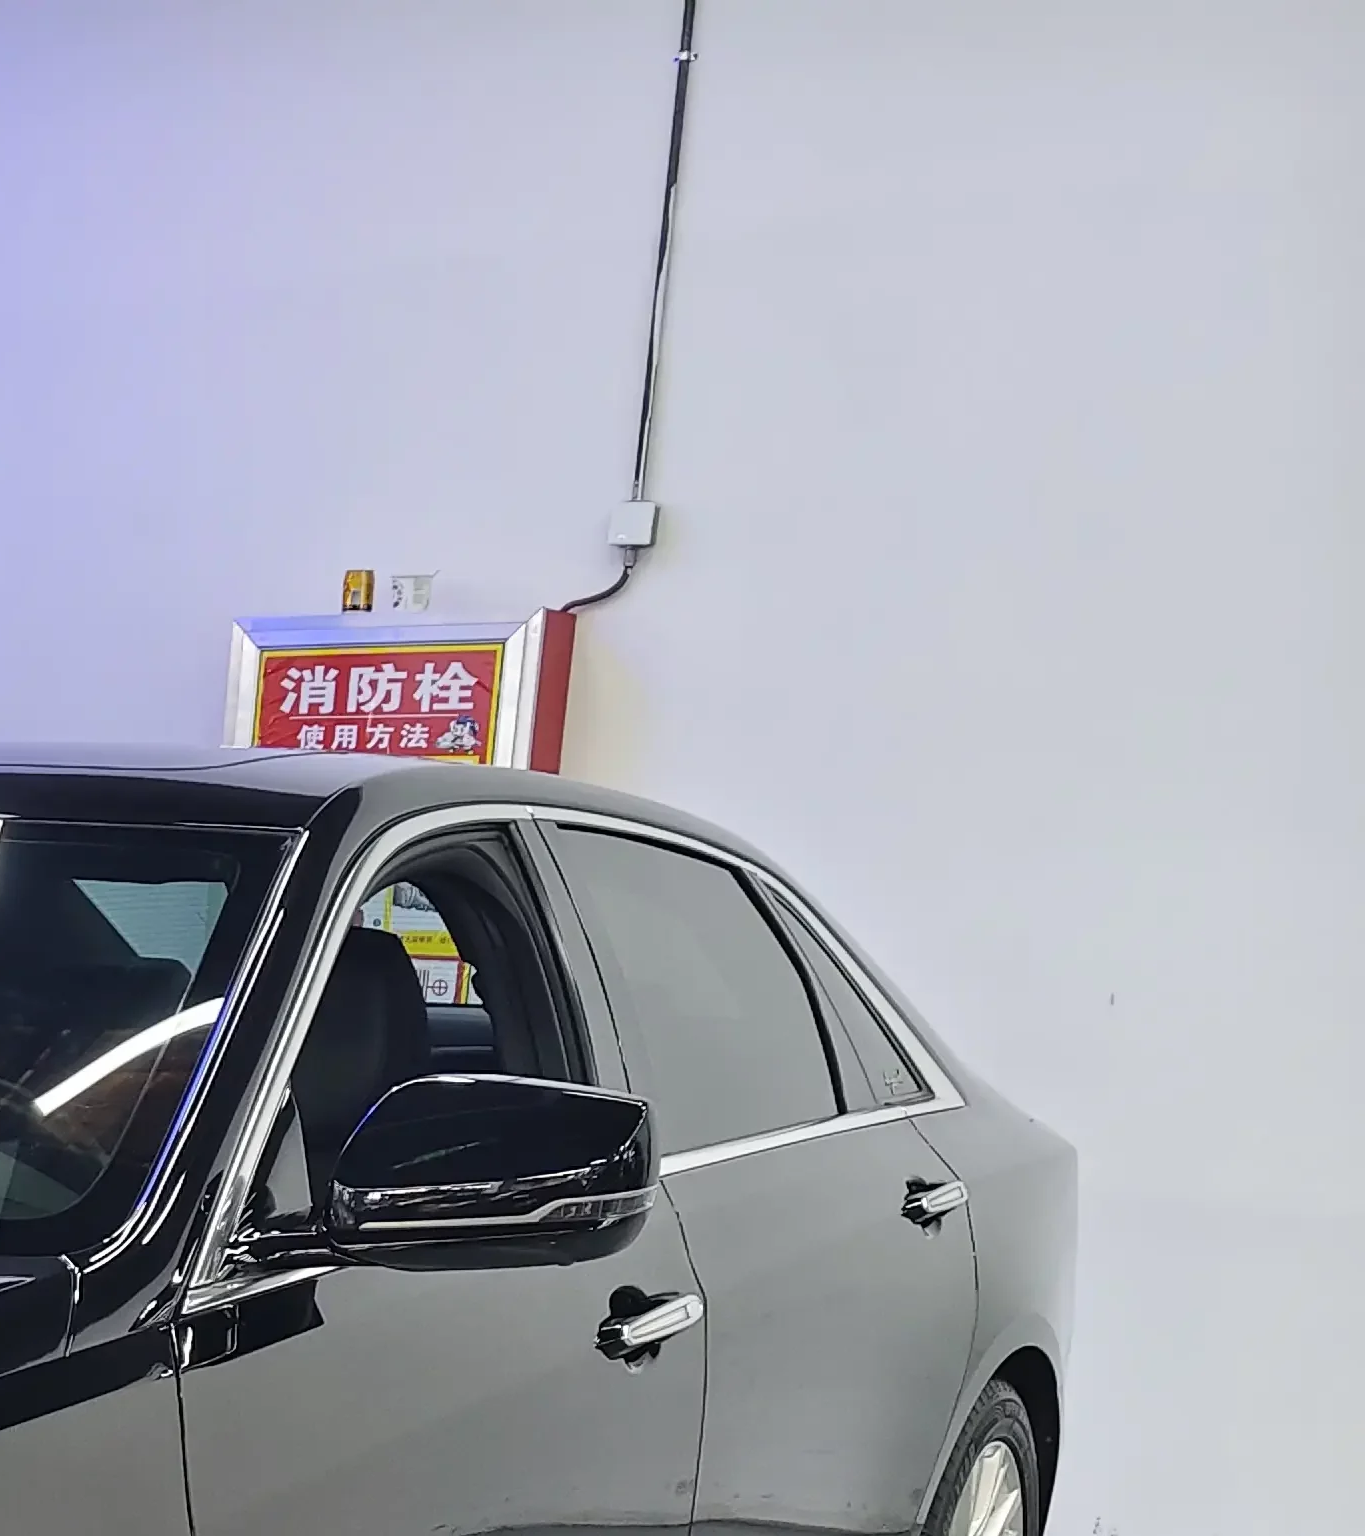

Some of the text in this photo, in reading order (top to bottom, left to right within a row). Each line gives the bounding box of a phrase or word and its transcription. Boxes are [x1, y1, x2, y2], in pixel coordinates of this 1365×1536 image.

[279, 661, 478, 715] 消防栓
[297, 723, 430, 750] 使用方法
